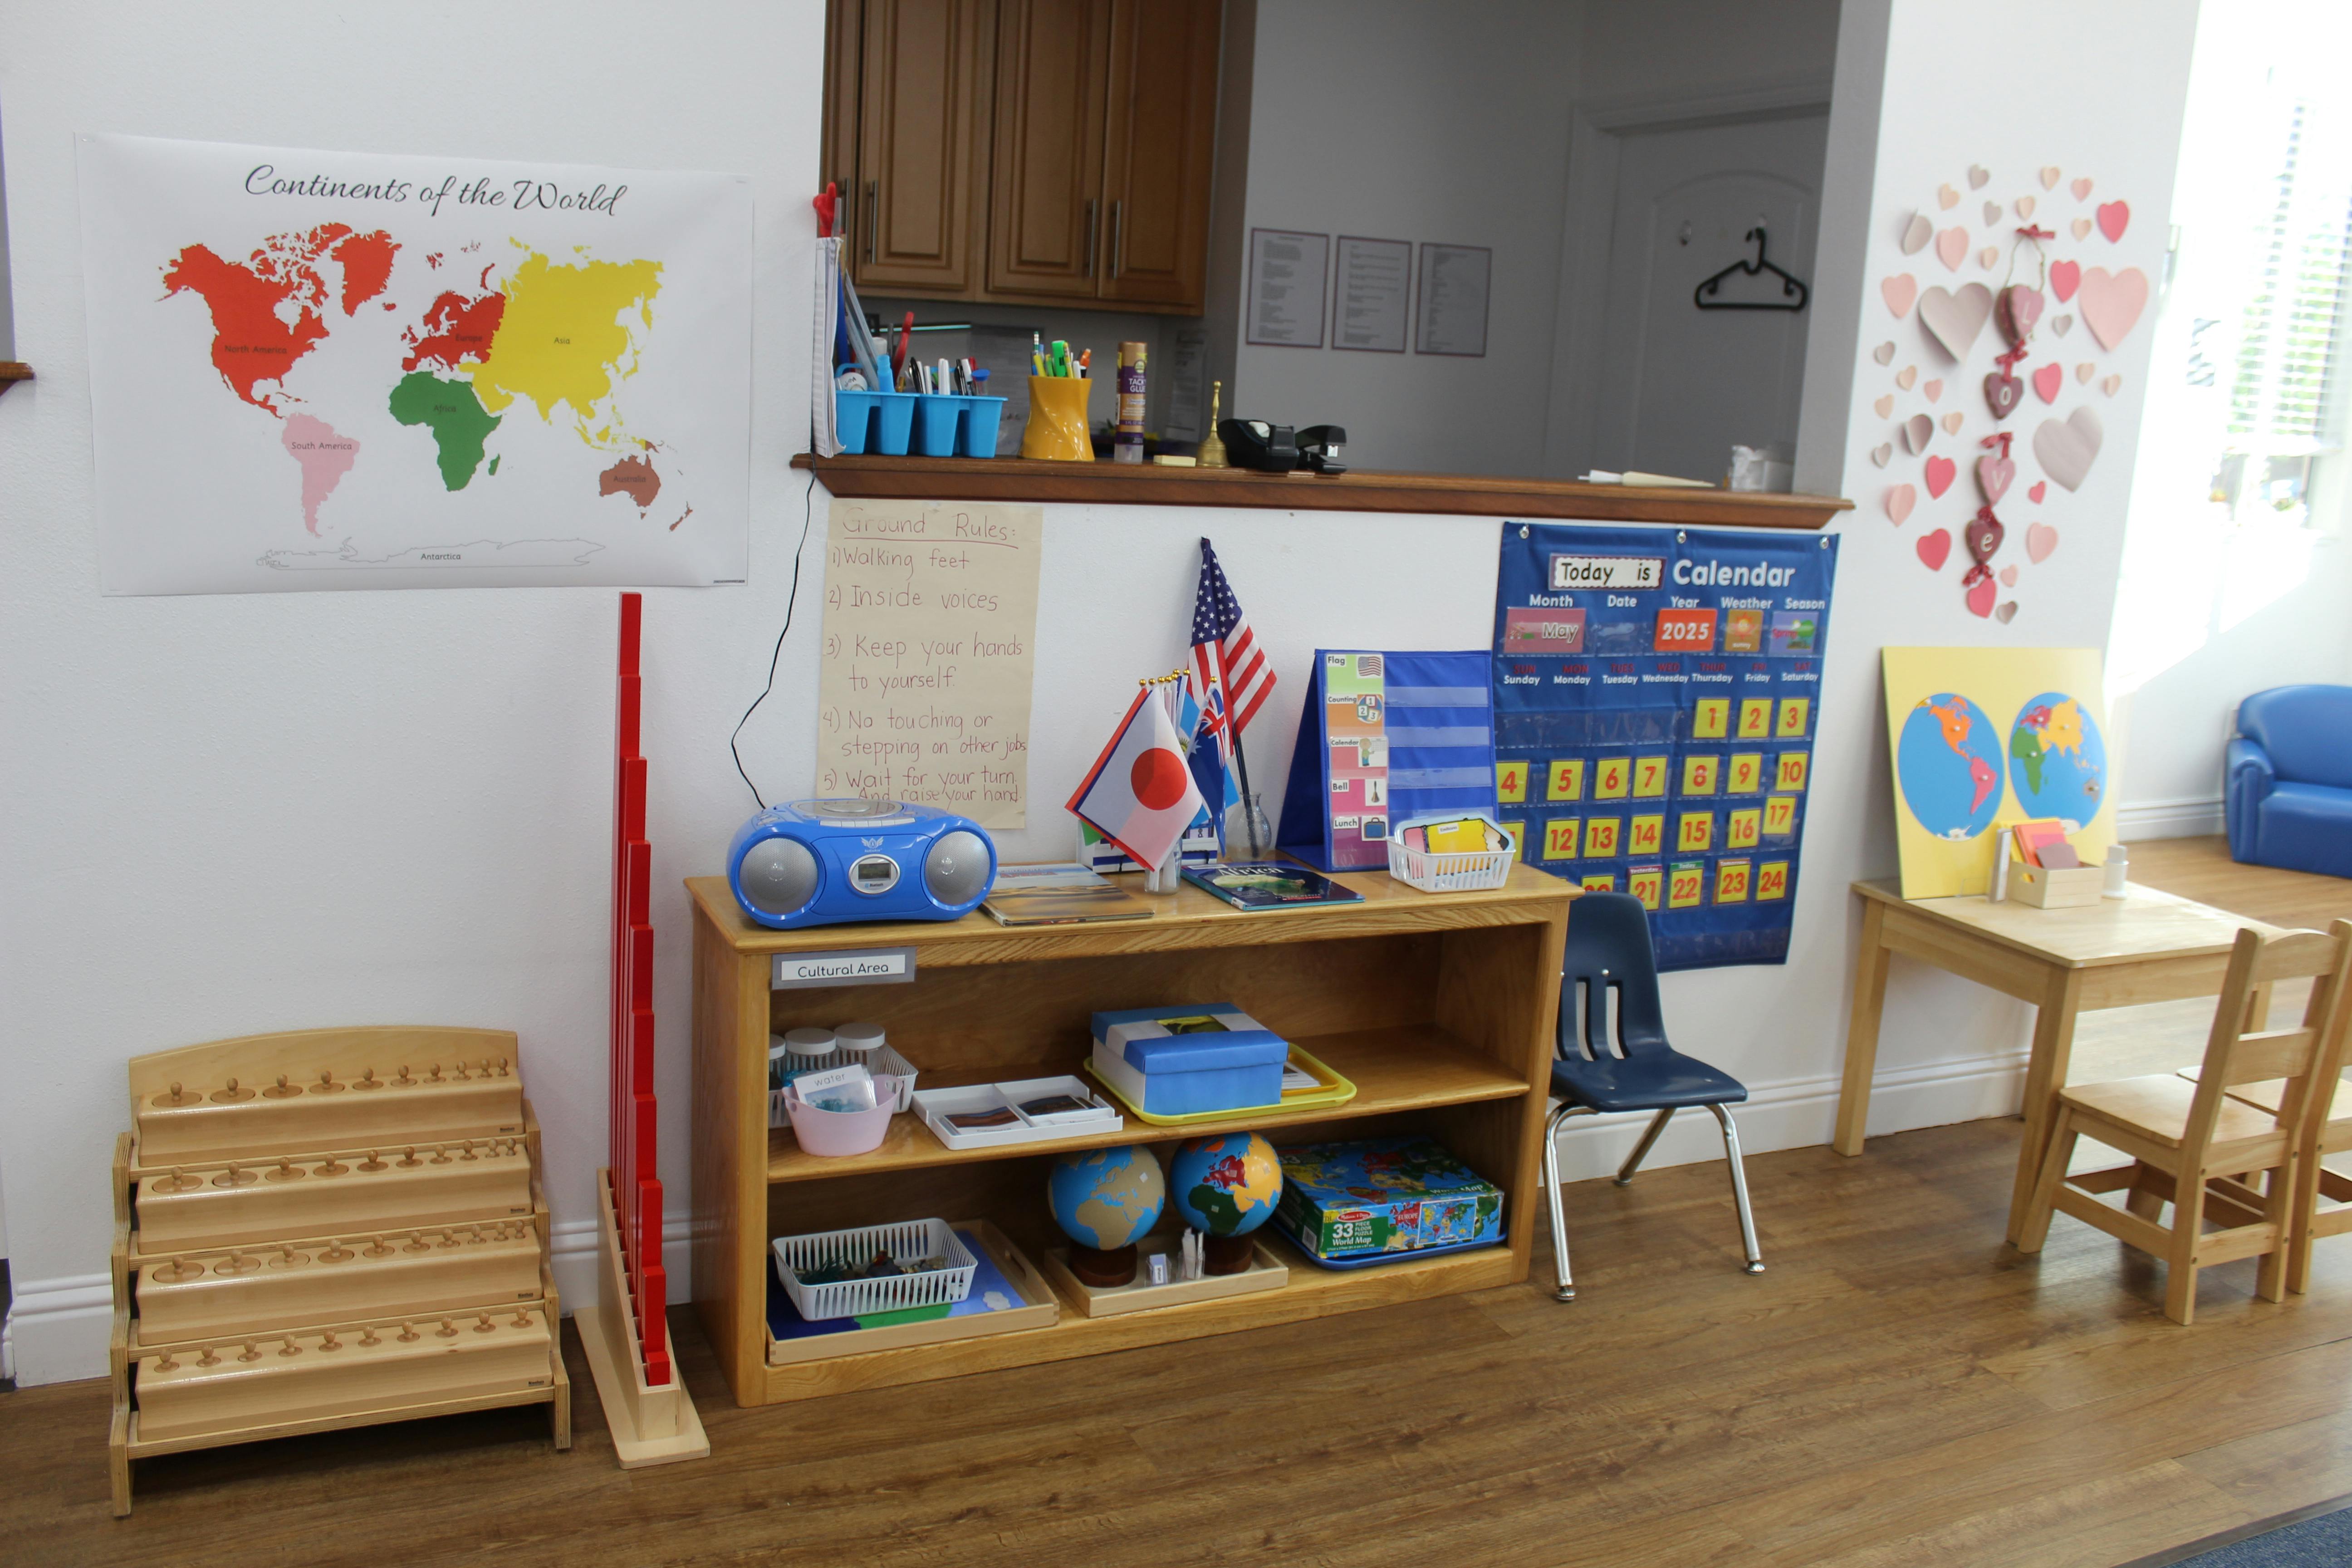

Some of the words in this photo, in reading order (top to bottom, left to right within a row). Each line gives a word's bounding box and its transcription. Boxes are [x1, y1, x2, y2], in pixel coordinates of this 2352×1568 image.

[245, 165, 411, 203] Continents
[419, 176, 456, 216] of
[459, 177, 506, 206] the
[514, 180, 627, 216] World
[456, 333, 483, 343] Europe
[554, 337, 571, 345] Asia
[225, 345, 249, 353] North
[252, 346, 287, 354] America
[433, 405, 456, 415] Africa
[291, 442, 316, 450] South
[318, 442, 352, 450] America
[613, 475, 646, 483] Australia
[843, 507, 925, 533] Ground
[956, 513, 1015, 540] Rules:
[929, 548, 970, 569] feet
[1561, 562, 1614, 586] Today
[1637, 563, 1651, 581] is
[1672, 559, 1796, 588] Calendar
[829, 584, 841, 611] 2)
[851, 582, 923, 607] Inside
[941, 588, 999, 611] voices
[1529, 594, 1574, 608] Month
[1607, 594, 1637, 608] Date
[1671, 595, 1700, 609] Year
[1720, 596, 1773, 609] Weather
[1784, 597, 1826, 610] Season
[1542, 622, 1579, 643] May
[1661, 622, 1710, 641] 2025
[825, 633, 841, 659] 3)
[856, 634, 906, 669] Keep
[921, 640, 963, 666] your
[974, 631, 1024, 657] hands
[1328, 656, 1345, 666] Flag
[1514, 664, 1536, 674] SUN
[1563, 664, 1589, 674] MON
[1611, 663, 1634, 673] TUES
[1656, 662, 1680, 672] WED
[1699, 662, 1725, 672] THUR
[1752, 662, 1767, 672] FRI
[1794, 662, 1812, 671] SAT
[849, 664, 868, 691] to
[879, 665, 956, 699] yourself.
[1504, 674, 1540, 686] Sunday
[1553, 674, 1591, 686] Monday
[1602, 674, 1638, 686] Tuesday
[1642, 673, 1689, 684] Wednesday
[1692, 673, 1733, 684] Thursday
[1744, 672, 1771, 683] Friday
[1782, 671, 1819, 683] Saturday
[1328, 696, 1357, 705] Counting
[1360, 707, 1367, 715] 2
[1370, 711, 1377, 720] 3
[1708, 708, 1716, 730] 1
[1748, 708, 1761, 730] 2
[1787, 707, 1798, 728] 3
[823, 706, 840, 733] 4)
[849, 710, 873, 729] No
[887, 705, 963, 740] touching
[974, 715, 993, 728] or
[841, 735, 920, 766] stepping
[932, 741, 948, 754] on
[960, 735, 1000, 754] other
[824, 768, 837, 791] 5)
[846, 767, 892, 788] Wait
[902, 766, 928, 786] for
[938, 772, 975, 795] your
[1558, 769, 1573, 792] 5
[1605, 768, 1619, 790] 6
[1645, 765, 1658, 789] 7
[1693, 764, 1708, 787] 8
[1739, 763, 1752, 784] 9
[1782, 761, 1803, 784] 10
[1333, 782, 1348, 791] Bell
[1501, 770, 1518, 794] 4
[858, 787, 890, 802] And
[900, 789, 940, 802] raise
[946, 789, 977, 811] your
[1334, 819, 1358, 828] Lunch
[1769, 805, 1790, 827] 17
[1635, 823, 1657, 846] 14
[1685, 821, 1707, 843] 15
[1734, 818, 1754, 840] 16
[1550, 828, 1574, 852] 12
[1591, 826, 1614, 849] 13
[1672, 877, 1698, 901] 22
[1722, 872, 1746, 895] 23
[1759, 870, 1783, 893] 24
[1635, 881, 1656, 902] 21
[798, 964, 853, 978] Cultural
[857, 963, 889, 975] Area
[814, 1073, 846, 1087] water
[1332, 1223, 1354, 1239] 33
[1333, 1237, 1353, 1246] World
